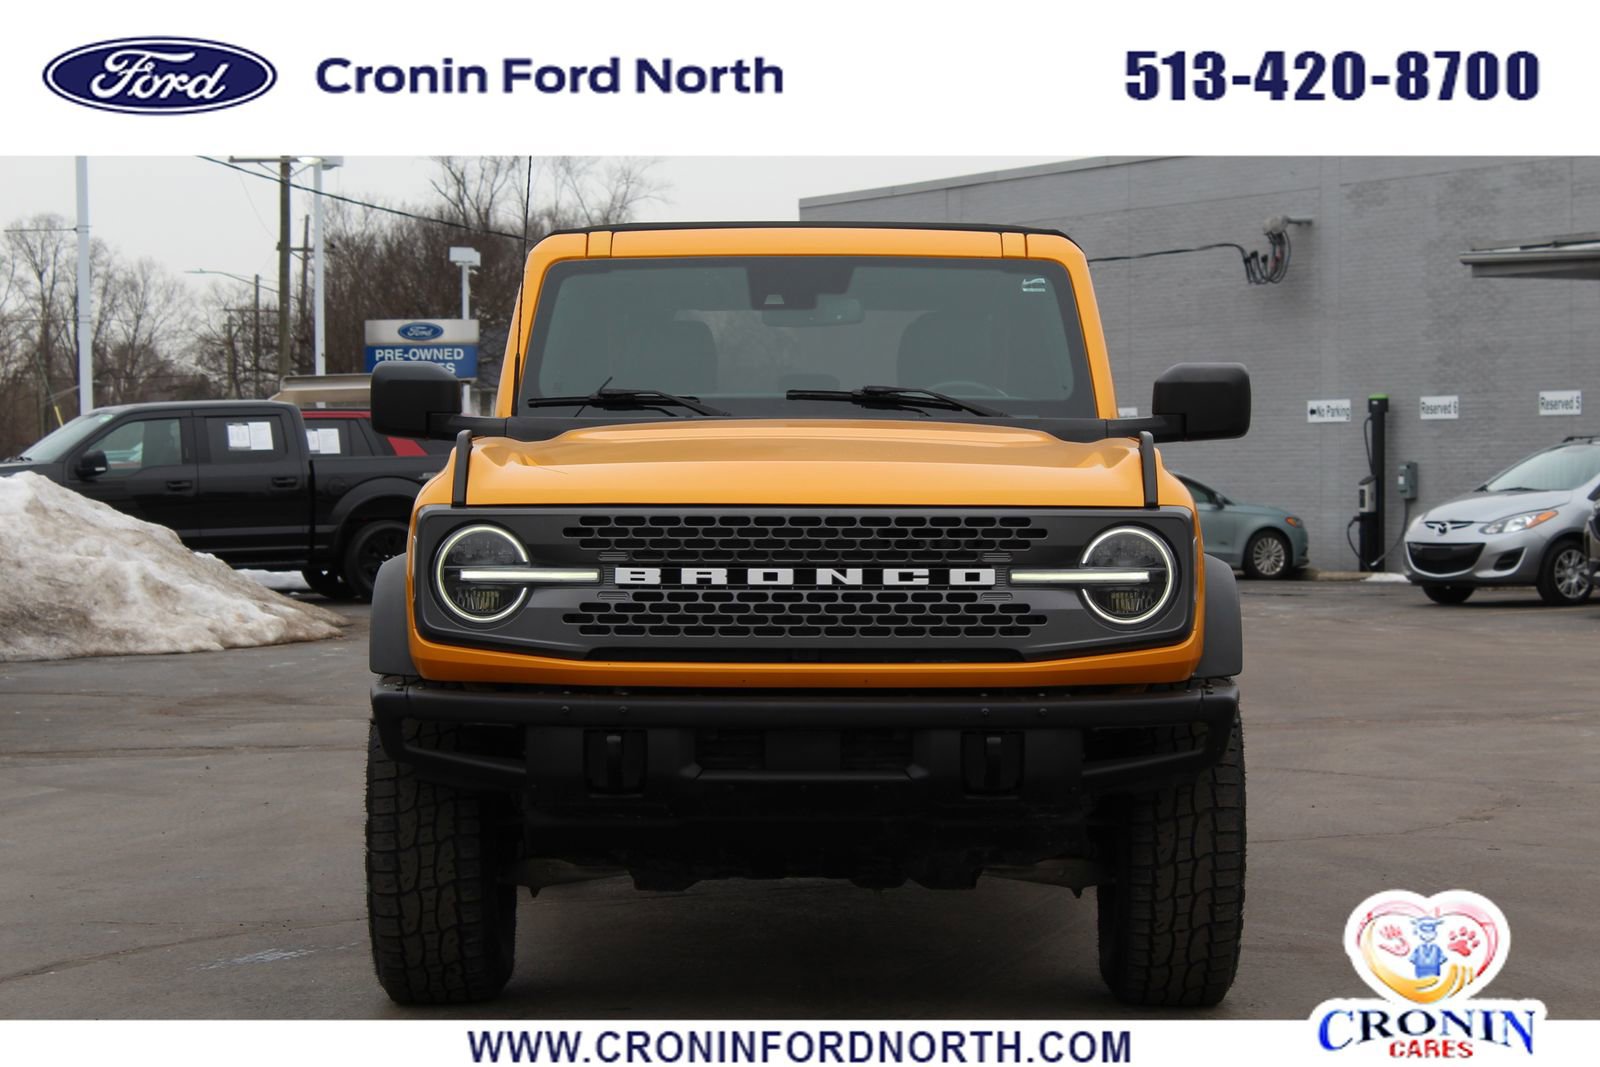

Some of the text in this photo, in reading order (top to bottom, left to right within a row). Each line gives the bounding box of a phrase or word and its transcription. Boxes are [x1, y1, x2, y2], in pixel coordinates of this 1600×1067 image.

[406, 326, 434, 337] Ford
[375, 348, 464, 361] PRE-OWNED
[1316, 404, 1350, 420] No Parking
[614, 567, 997, 586] BRONCO
